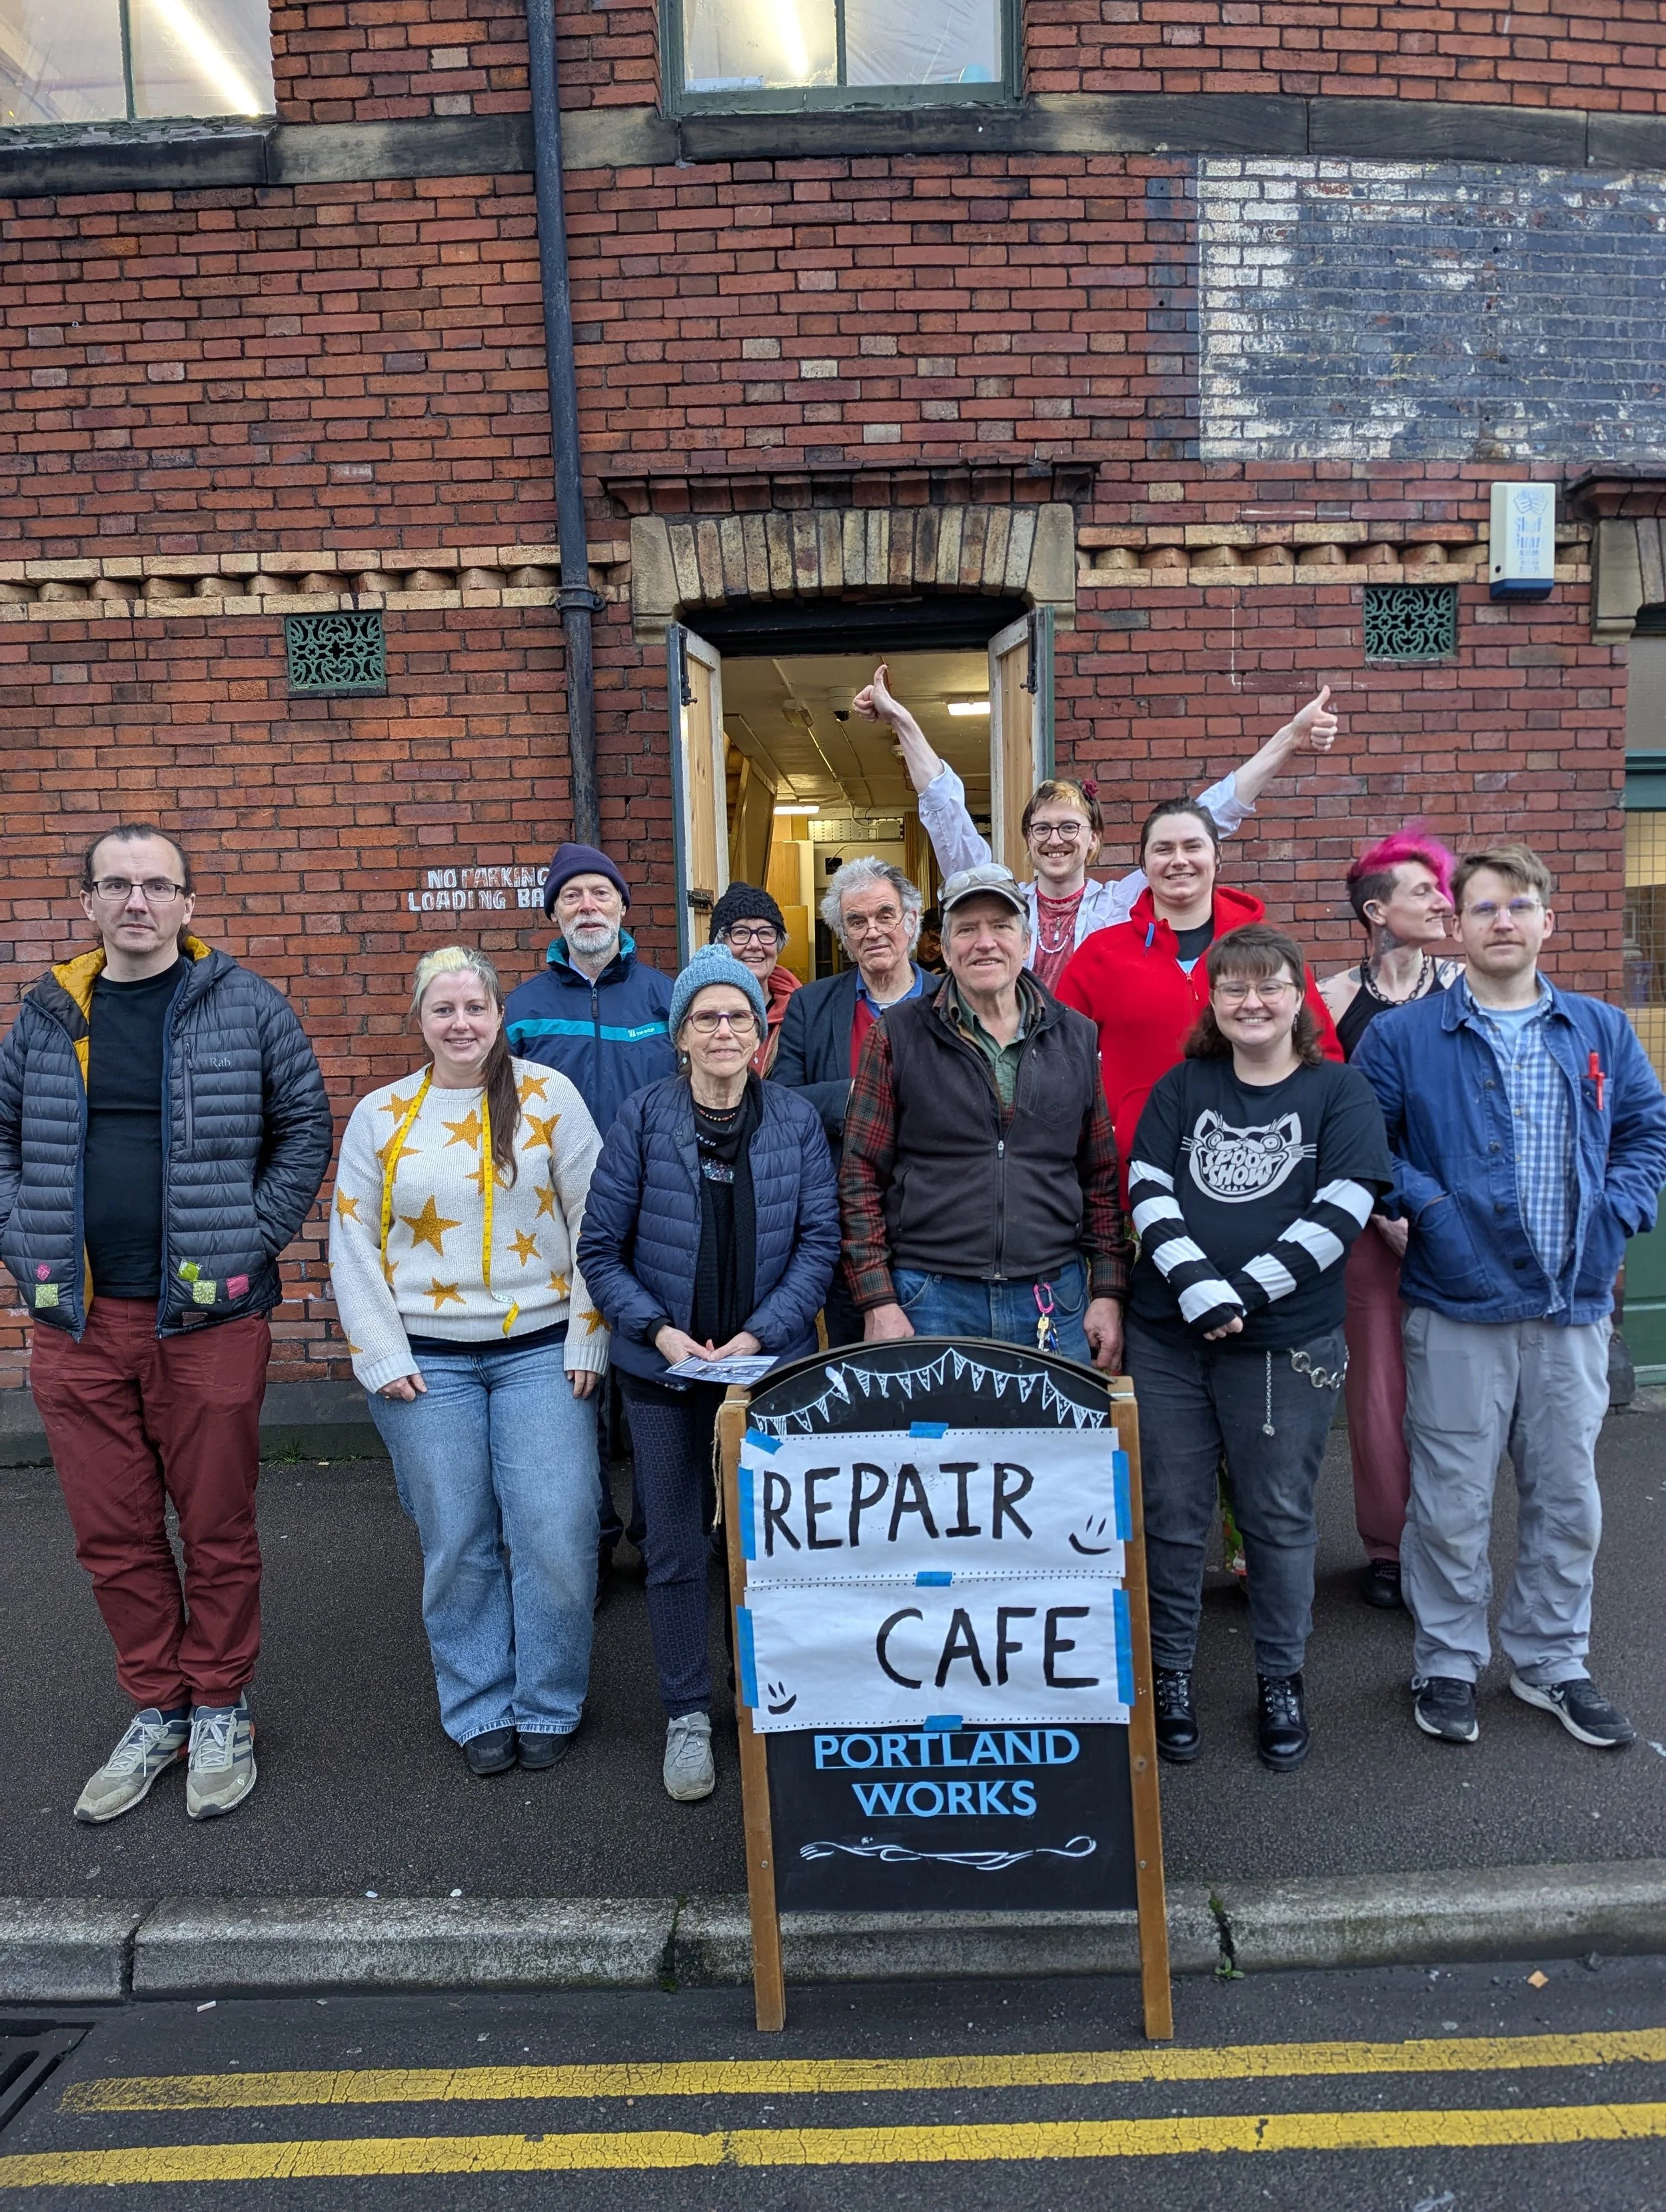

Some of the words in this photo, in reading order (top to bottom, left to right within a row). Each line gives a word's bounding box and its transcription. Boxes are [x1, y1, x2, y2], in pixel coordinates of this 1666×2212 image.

[427, 868, 457, 888] NO
[461, 867, 550, 888] PARKING
[408, 889, 506, 911] LOADING
[517, 887, 544, 908] BA
[210, 1057, 231, 1072] Rab
[1202, 1149, 1282, 1175] SPOOK
[1208, 1164, 1271, 1187] SHOW
[763, 1462, 1034, 1557] REPAIR
[876, 1607, 1100, 1689] CAFE
[814, 1728, 1081, 1770] PORTLAND
[852, 1780, 1038, 1817] WORKS
